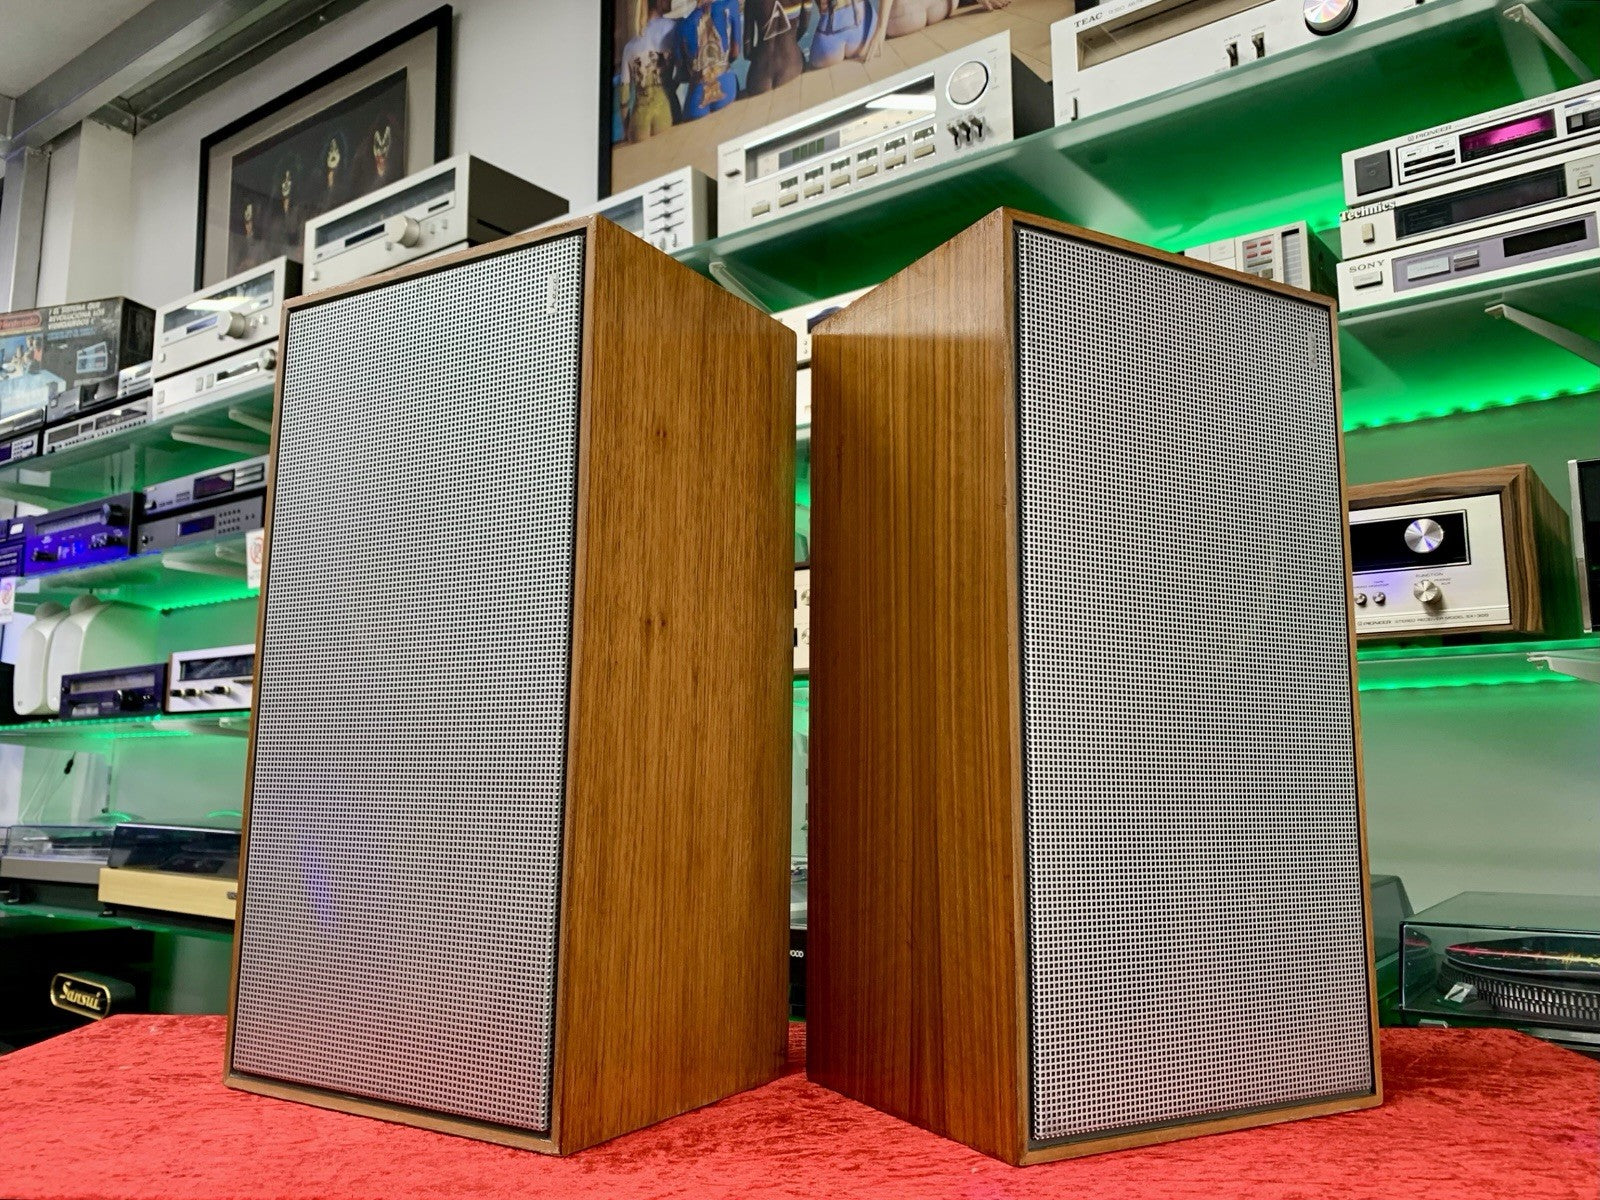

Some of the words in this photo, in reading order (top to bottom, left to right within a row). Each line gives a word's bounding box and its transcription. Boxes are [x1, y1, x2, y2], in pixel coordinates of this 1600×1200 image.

[1073, 12, 1103, 28] TEAC
[1415, 125, 1452, 140] PIONEER
[1340, 201, 1396, 222] Technics
[1349, 259, 1385, 273] SONY
[59, 981, 101, 1010] Sansui
